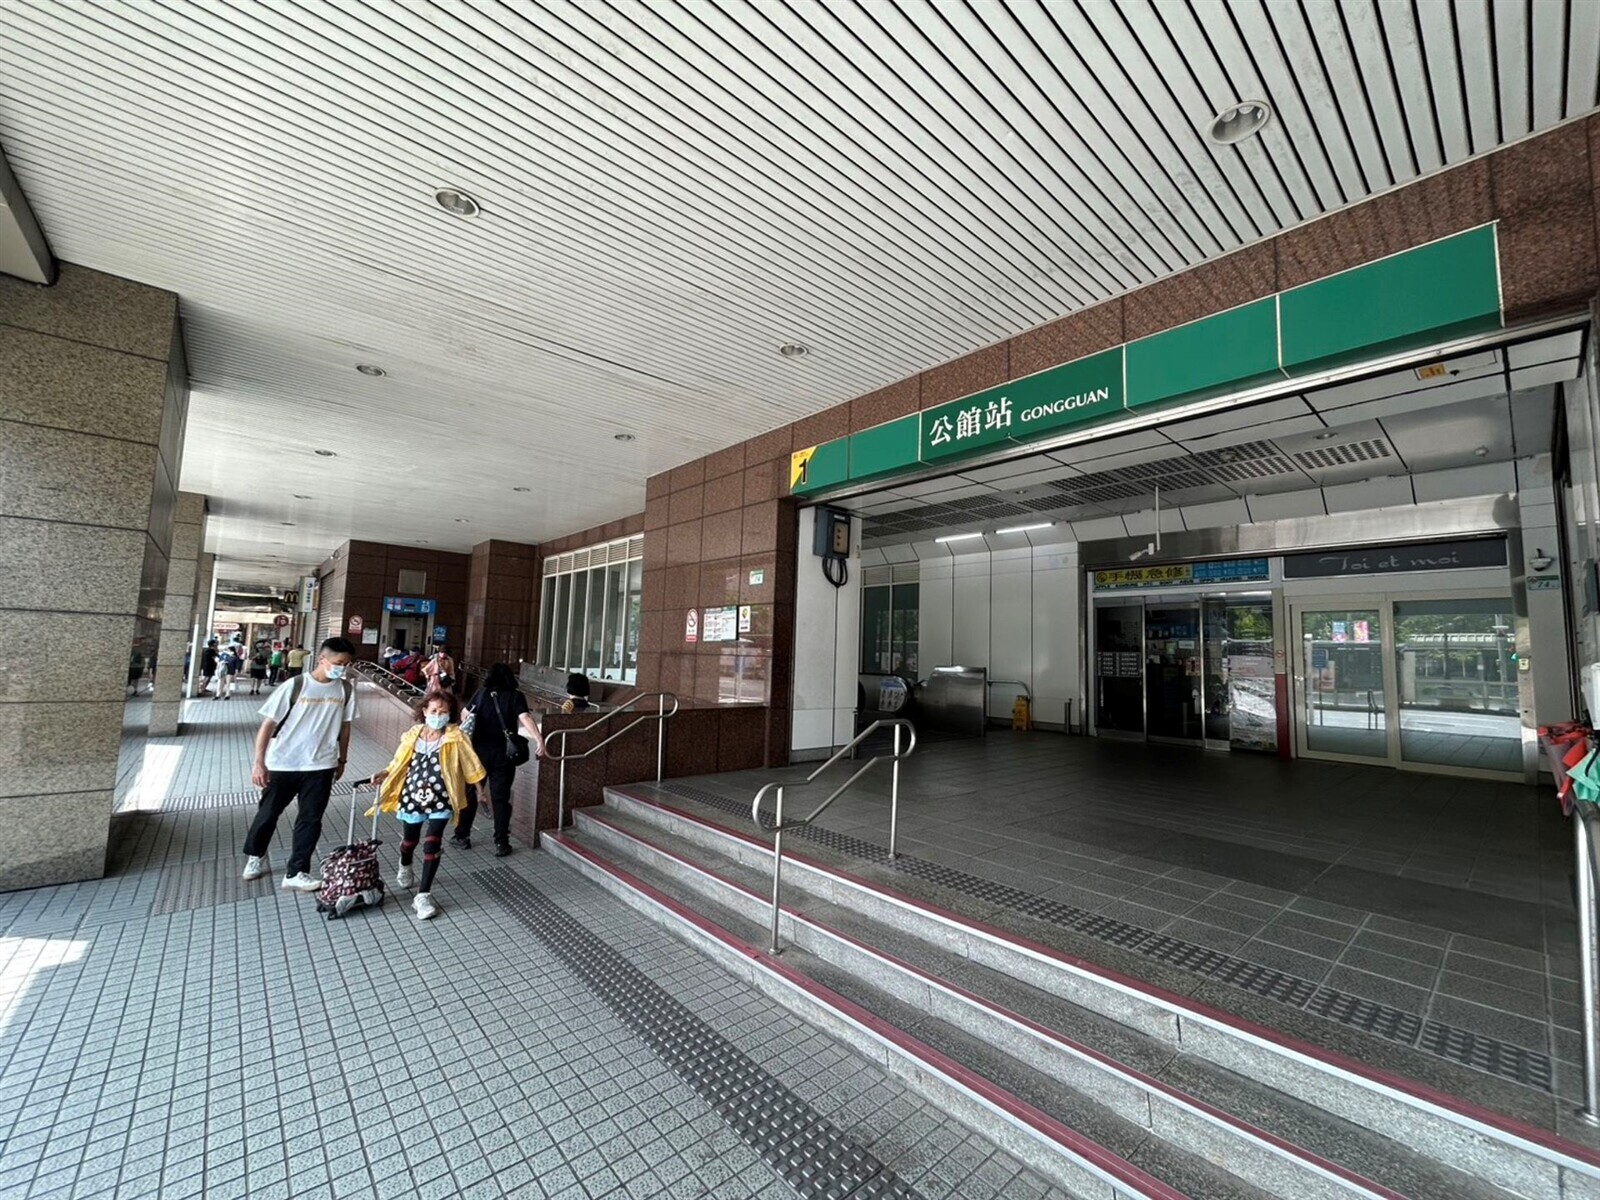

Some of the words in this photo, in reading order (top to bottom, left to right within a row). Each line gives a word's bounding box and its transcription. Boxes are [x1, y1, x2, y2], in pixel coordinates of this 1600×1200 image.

[1020, 387, 1109, 423] GONGGUAN
[929, 397, 1014, 446] 公館站
[799, 458, 808, 484] 1
[1319, 556, 1371, 570] Toi
[1378, 555, 1400, 568] et
[1411, 551, 1461, 567] moi
[1108, 566, 1184, 582] 手機急修
